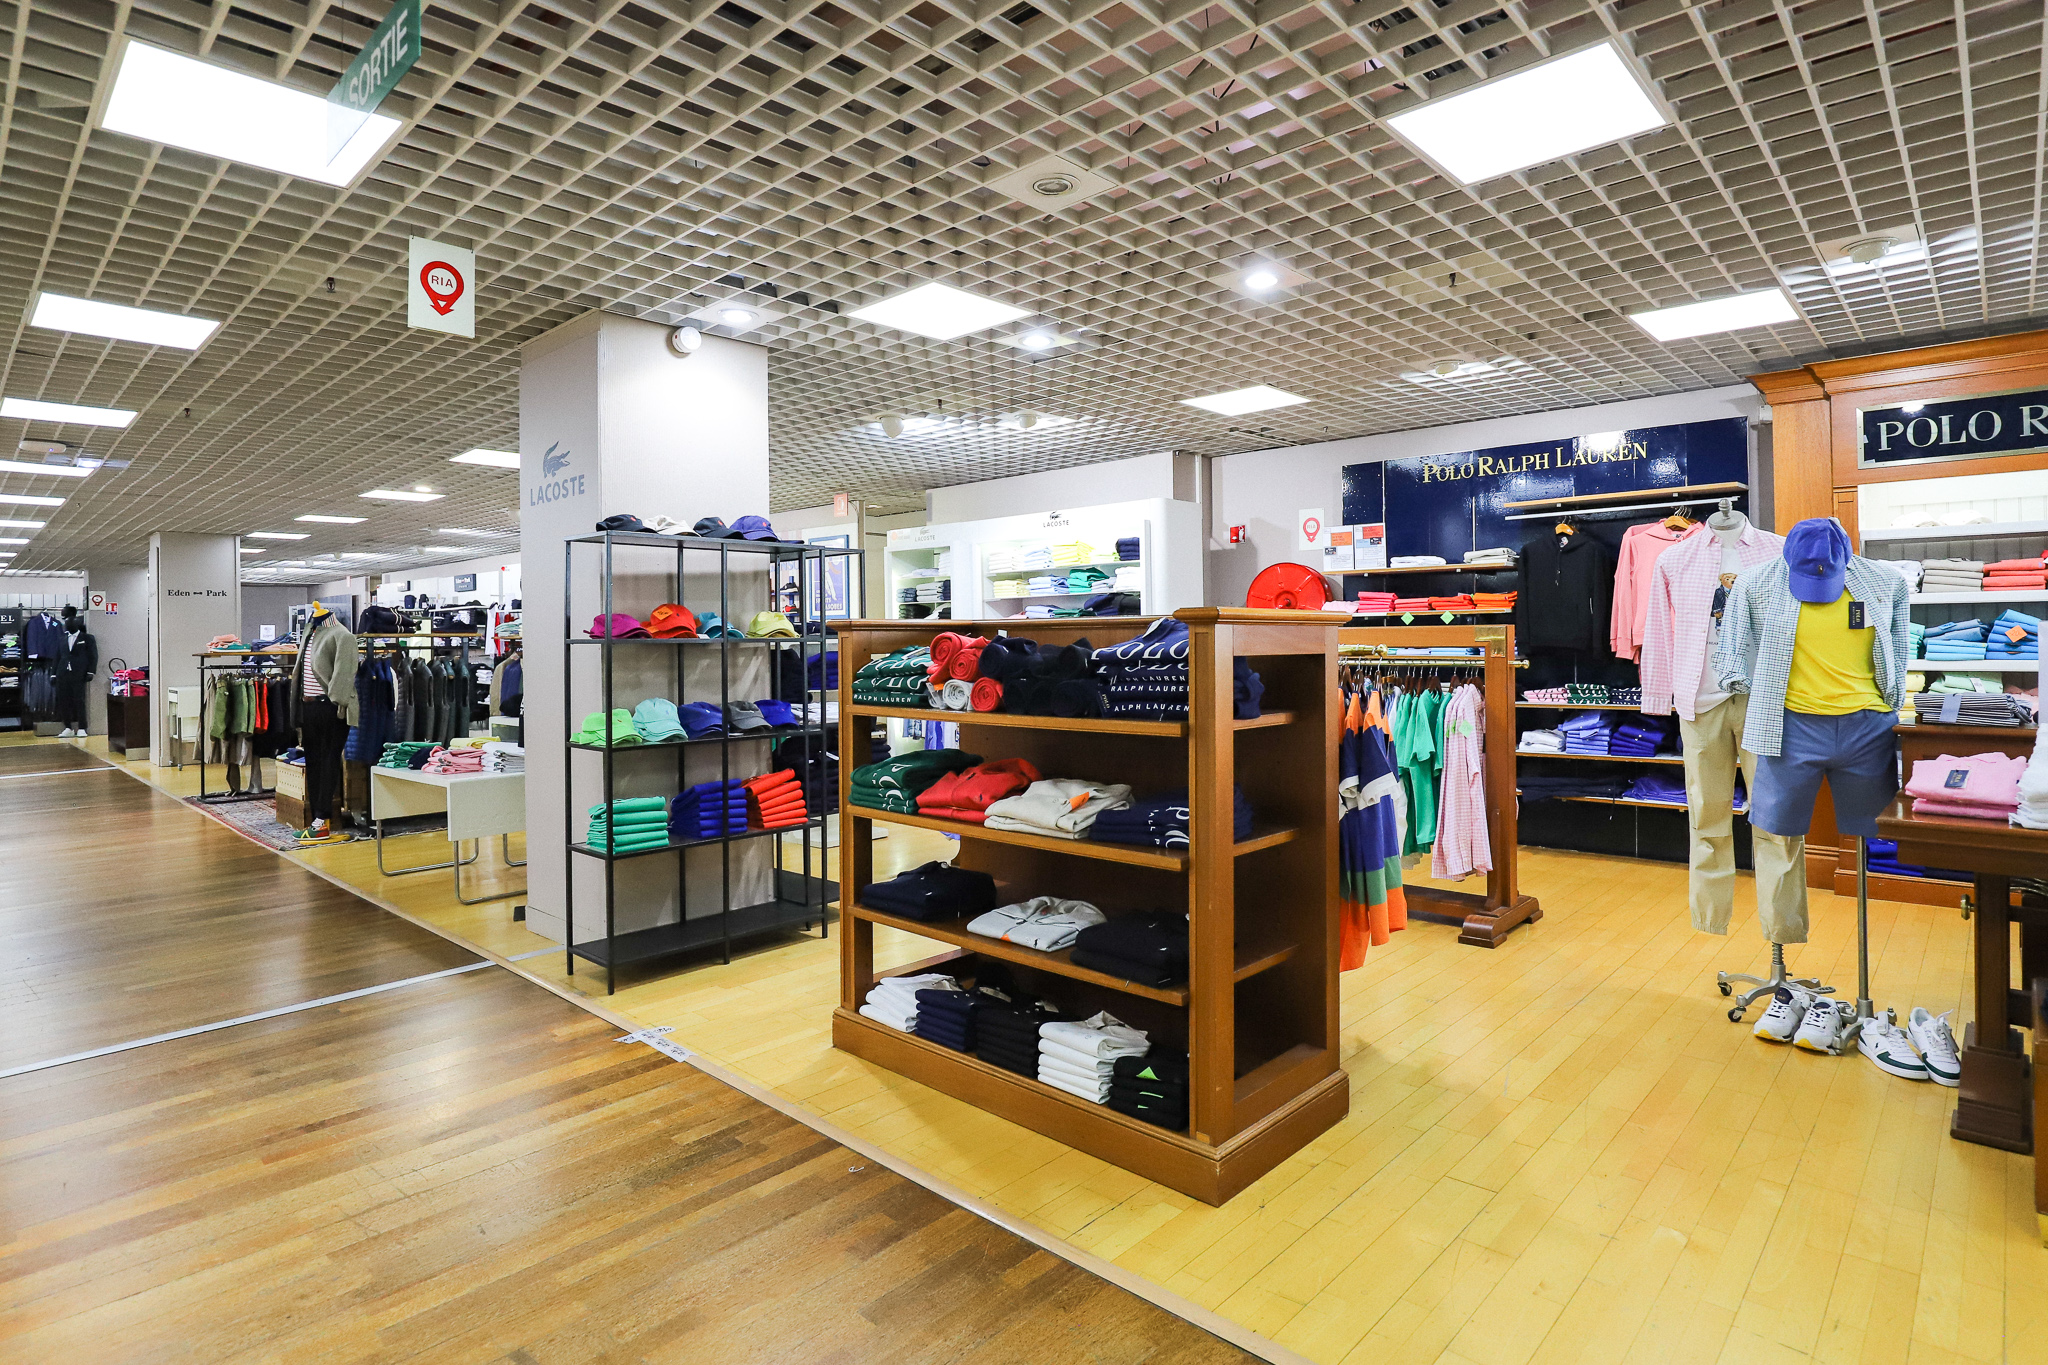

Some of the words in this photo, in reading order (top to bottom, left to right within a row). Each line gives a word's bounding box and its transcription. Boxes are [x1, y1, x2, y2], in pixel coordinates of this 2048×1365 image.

[349, 8, 408, 111] SORTIE
[431, 275, 454, 288] RIA
[1877, 410, 2002, 451] POLO
[2019, 404, 2048, 437] R
[1423, 462, 1475, 483] POLO
[1477, 452, 1550, 477] RALPH
[1555, 441, 1648, 468] LAUREN
[530, 474, 585, 507] LACOSTE
[1043, 519, 1069, 528] LACOSTE
[914, 534, 936, 542] LACOSTE
[167, 589, 190, 597] Eden
[206, 589, 227, 597] Park
[853, 694, 878, 702] RALPH
[1114, 703, 1141, 712] ALPH
